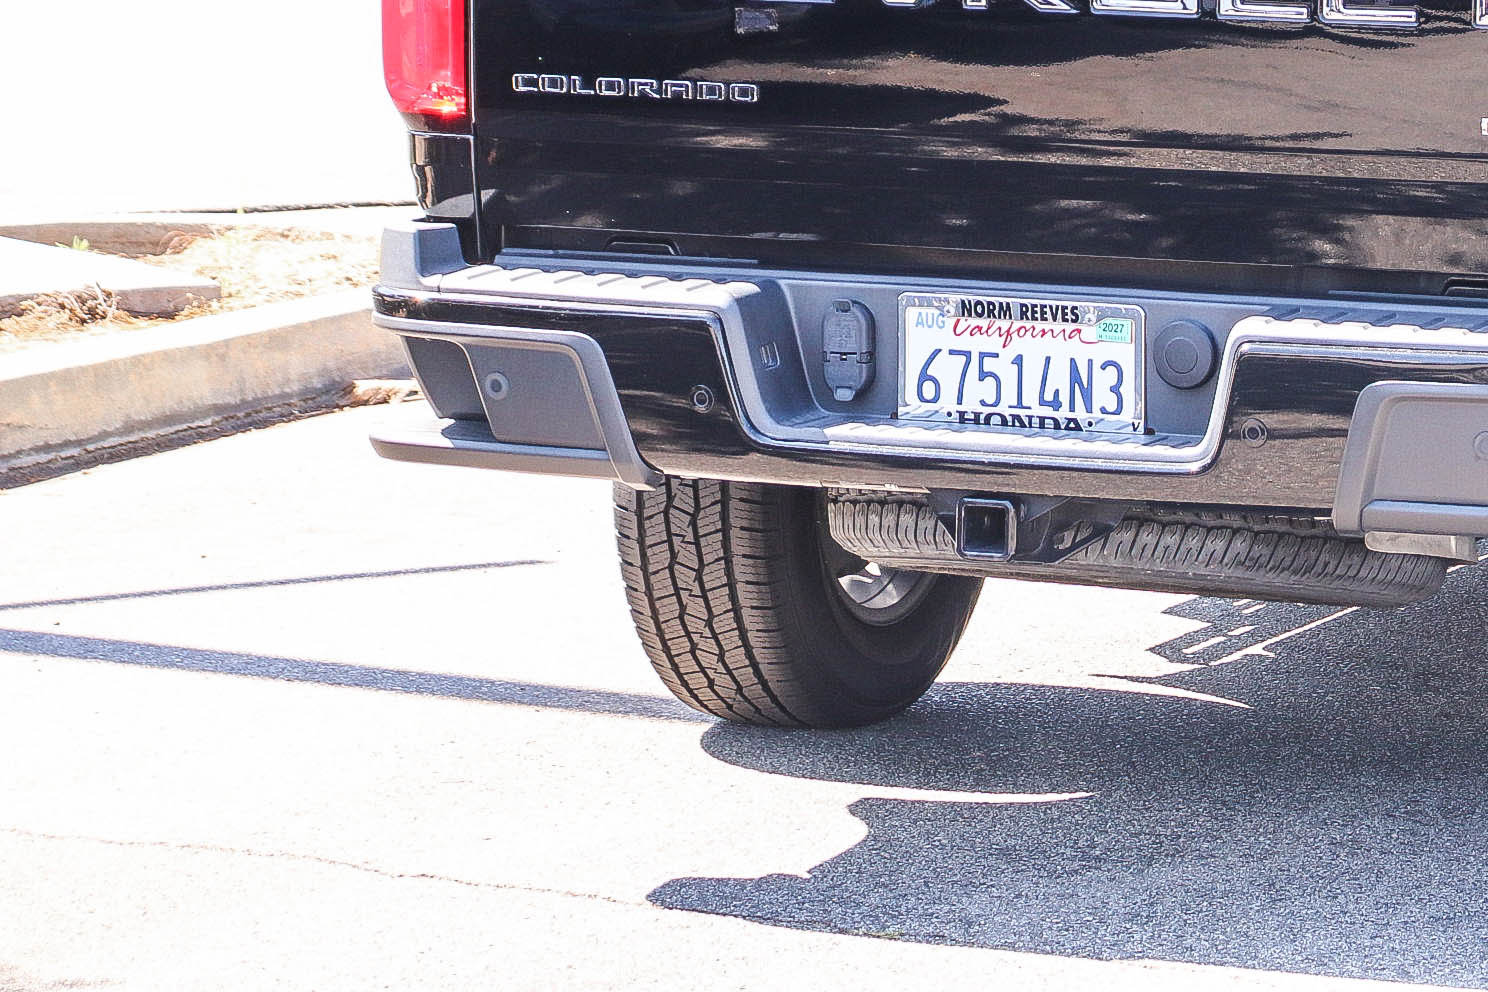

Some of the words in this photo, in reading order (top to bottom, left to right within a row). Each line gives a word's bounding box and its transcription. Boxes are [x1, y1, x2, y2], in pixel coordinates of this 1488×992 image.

[511, 72, 761, 103] COLORADO
[915, 311, 946, 330] AUG
[960, 299, 1013, 321] NORM
[1019, 302, 1081, 324] REEVES
[952, 317, 1099, 349] California
[1102, 322, 1125, 334] 2027
[916, 348, 1124, 416] 67514N3
[956, 410, 1084, 431] HONDA
